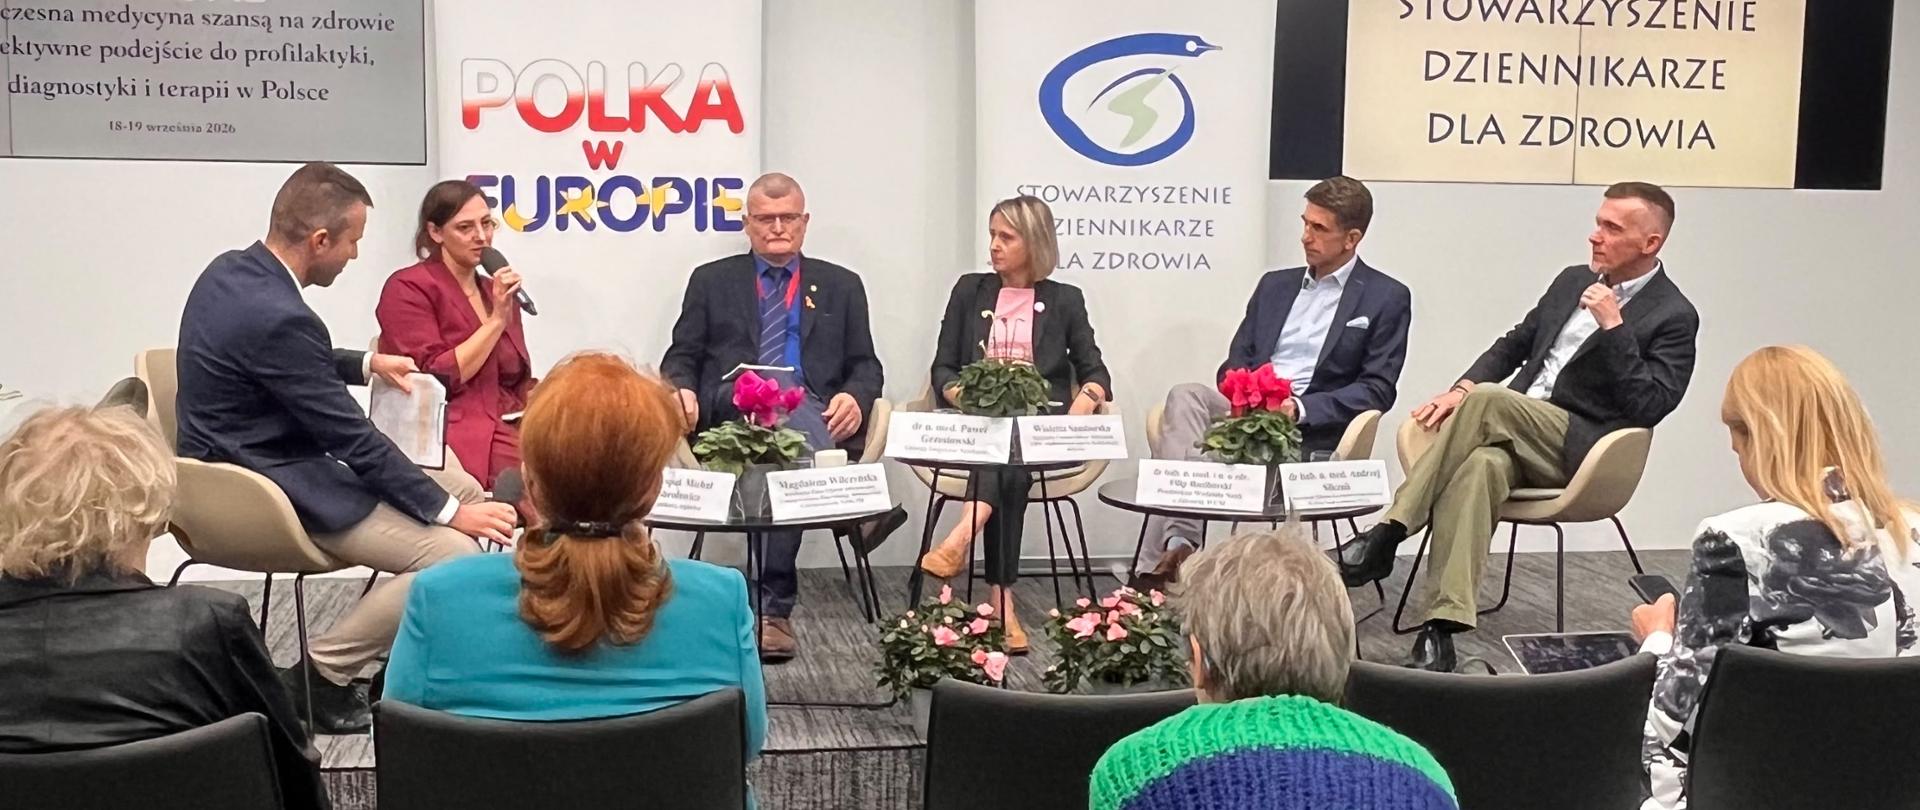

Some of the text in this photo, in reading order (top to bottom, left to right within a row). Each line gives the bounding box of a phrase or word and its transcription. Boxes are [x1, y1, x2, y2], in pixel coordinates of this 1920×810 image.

[0, 4, 395, 34] czesna medycyna szansą na zdrowie
[0, 34, 375, 68] ektywne podejście do profilaktyki,
[1424, 50, 1728, 91] DZIENNIKARZE
[8, 74, 330, 104] diagnostyki i terapii w Polsce
[461, 58, 744, 133] POLKA
[109, 120, 143, 132] 18-19
[206, 122, 236, 134] 2026
[1428, 112, 1716, 150] DLA ZDROWIA
[1017, 184, 1232, 204] STOWARZYSZENIE
[1054, 218, 1215, 237] ZIENNIKARZE
[1056, 252, 1211, 270] LA ZDROWIA
